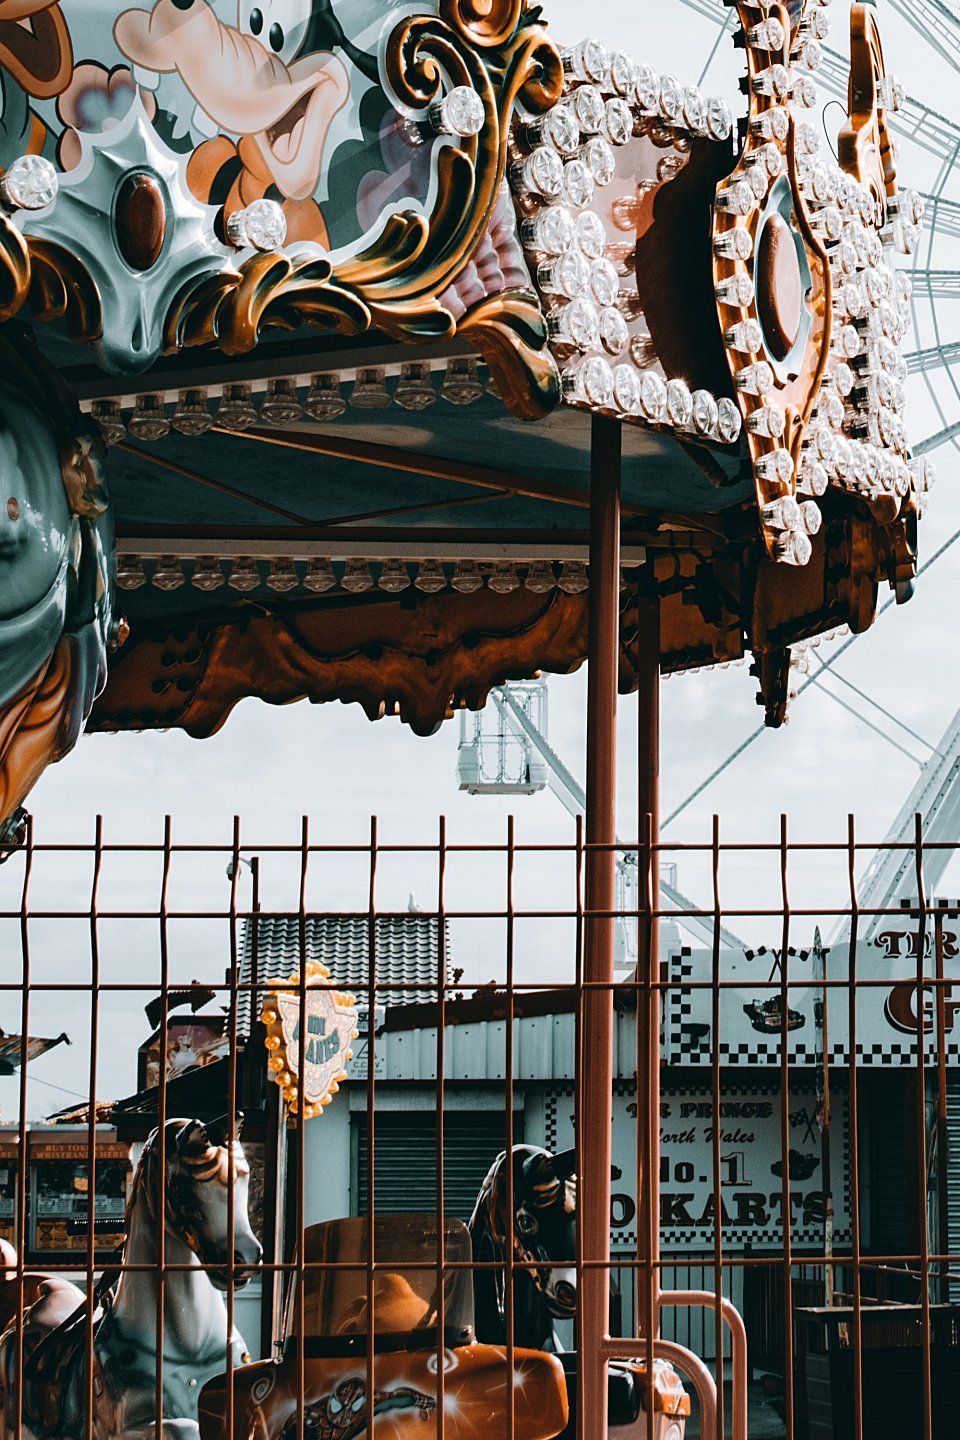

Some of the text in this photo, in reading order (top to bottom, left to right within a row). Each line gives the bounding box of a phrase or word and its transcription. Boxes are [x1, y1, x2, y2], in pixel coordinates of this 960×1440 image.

[874, 930, 960, 959] TIR
[626, 1103, 671, 1119] TR
[656, 1127, 696, 1143] orth
[720, 1151, 753, 1187] 1
[657, 1190, 833, 1228] KARTS
